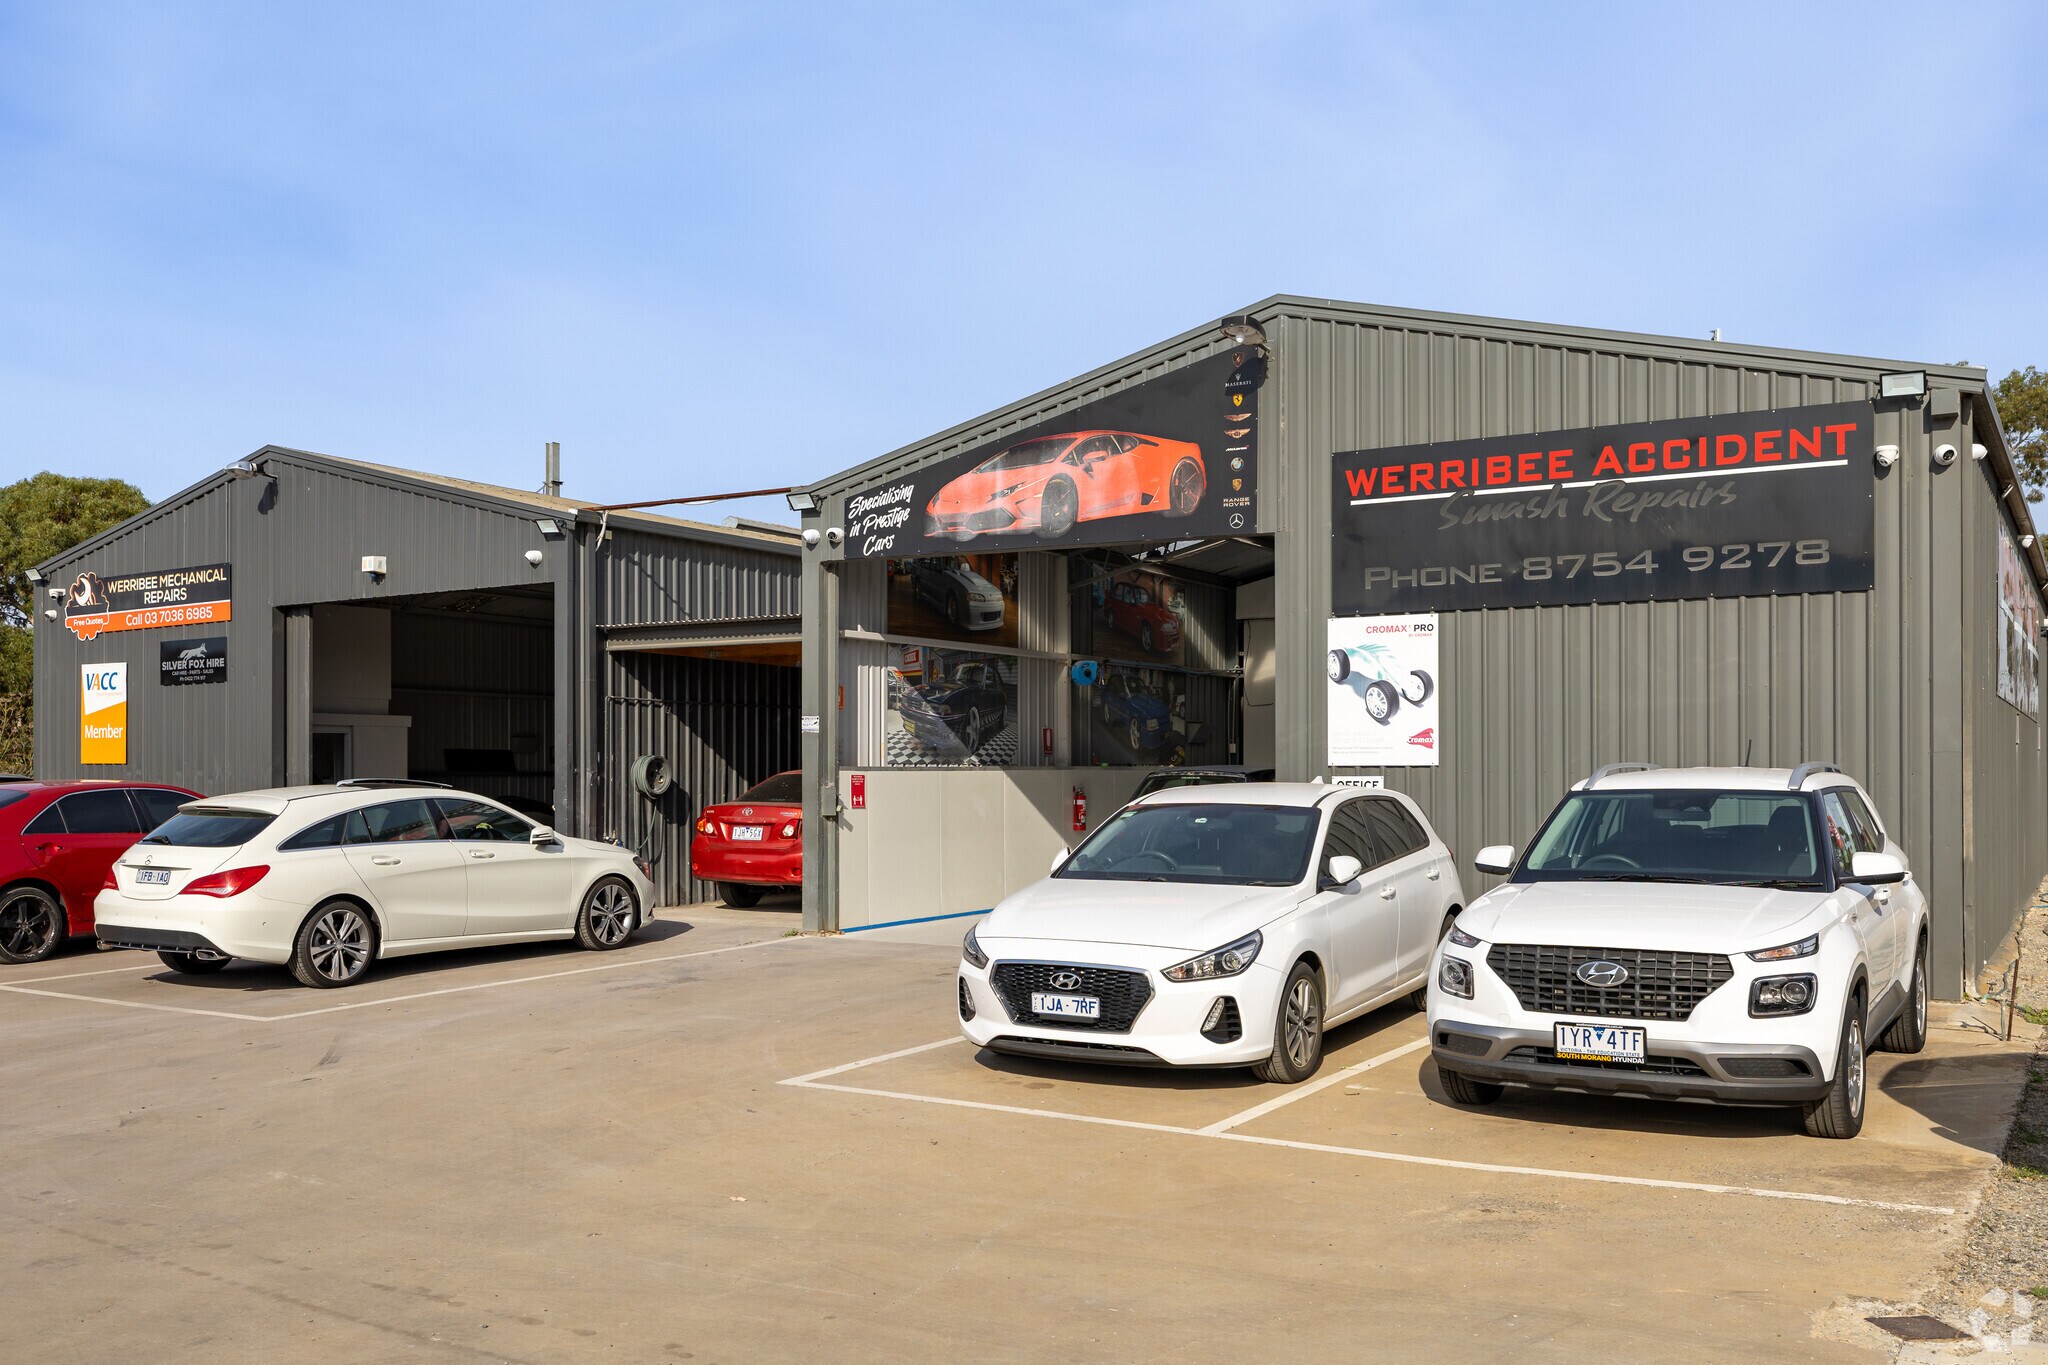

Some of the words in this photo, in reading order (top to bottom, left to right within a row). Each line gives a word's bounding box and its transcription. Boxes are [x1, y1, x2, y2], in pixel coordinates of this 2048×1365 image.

[1345, 449, 1574, 497] WERRIBEE
[1592, 423, 1857, 476] ACCIDENT
[848, 484, 914, 519] Specialising
[1438, 483, 1567, 530] Smash
[1583, 480, 1737, 523] Repairs
[849, 520, 861, 538] in
[863, 507, 910, 535] Prestige
[863, 534, 895, 556] Cars
[1364, 563, 1502, 590] PHONE
[1522, 550, 1659, 581] 8754
[1682, 539, 1830, 572] 9278
[108, 576, 157, 594] WERRIBEE
[160, 568, 227, 588] MECHANICAL
[144, 588, 188, 604] REPAIRS
[126, 614, 142, 626] Call
[145, 612, 157, 624] 03
[160, 609, 184, 623] 7036
[186, 607, 212, 620] 6985
[1413, 624, 1434, 632] PRO
[162, 660, 187, 671] SILVER
[189, 659, 205, 669] FOX
[206, 658, 224, 668] HIRE
[86, 672, 118, 690] VACC
[85, 724, 123, 739] Member
[1581, 1054, 1612, 1062] MORANG
